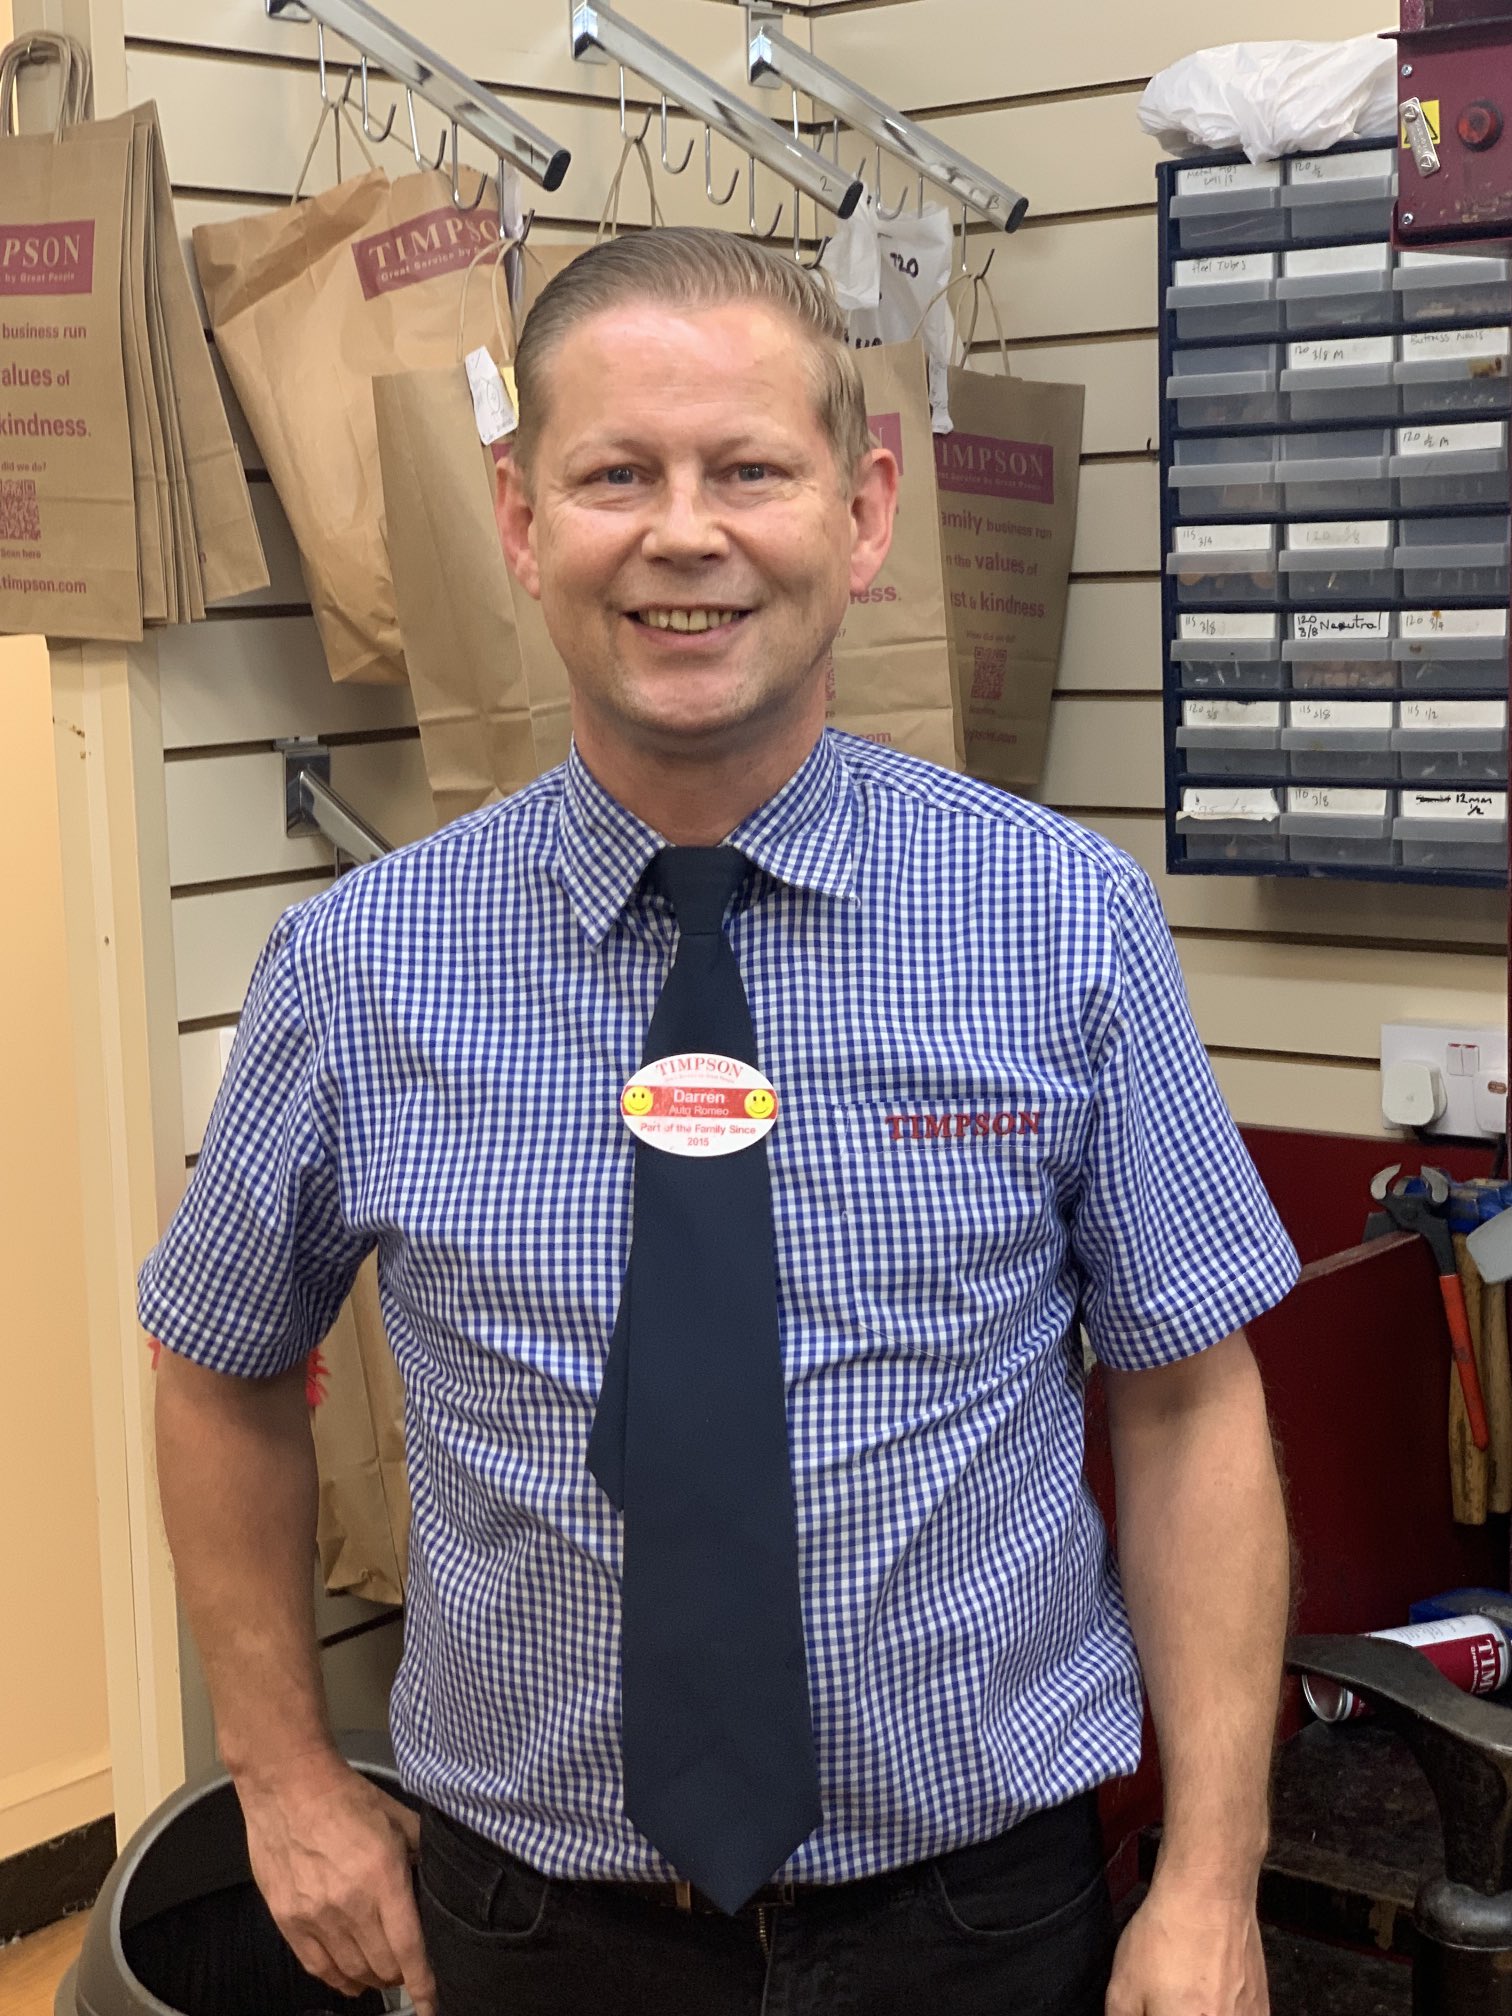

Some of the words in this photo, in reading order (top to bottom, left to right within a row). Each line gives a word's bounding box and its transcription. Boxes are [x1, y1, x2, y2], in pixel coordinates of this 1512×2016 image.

[2, 321, 60, 340] business
[63, 325, 88, 340] run
[56, 368, 71, 387] of
[935, 440, 1045, 480] IMPSON
[986, 516, 1033, 537] business
[975, 552, 1025, 575] values
[1026, 562, 1039, 577] of
[1297, 615, 1317, 626] 120
[1405, 615, 1424, 627] 120
[1298, 624, 1319, 639] 3/8
[1425, 707, 1439, 721] 1/2
[655, 1057, 743, 1079] TIMPSON
[673, 1089, 725, 1104] Darren
[669, 1105, 693, 1117] Auto
[694, 1105, 730, 1117] Romeo
[640, 1122, 662, 1132] Part
[664, 1122, 673, 1132] of
[675, 1122, 692, 1132] the
[695, 1123, 727, 1136] Family
[729, 1125, 756, 1135] Since
[885, 1111, 1041, 1141] TIMPSON
[687, 1136, 710, 1147] 2015
